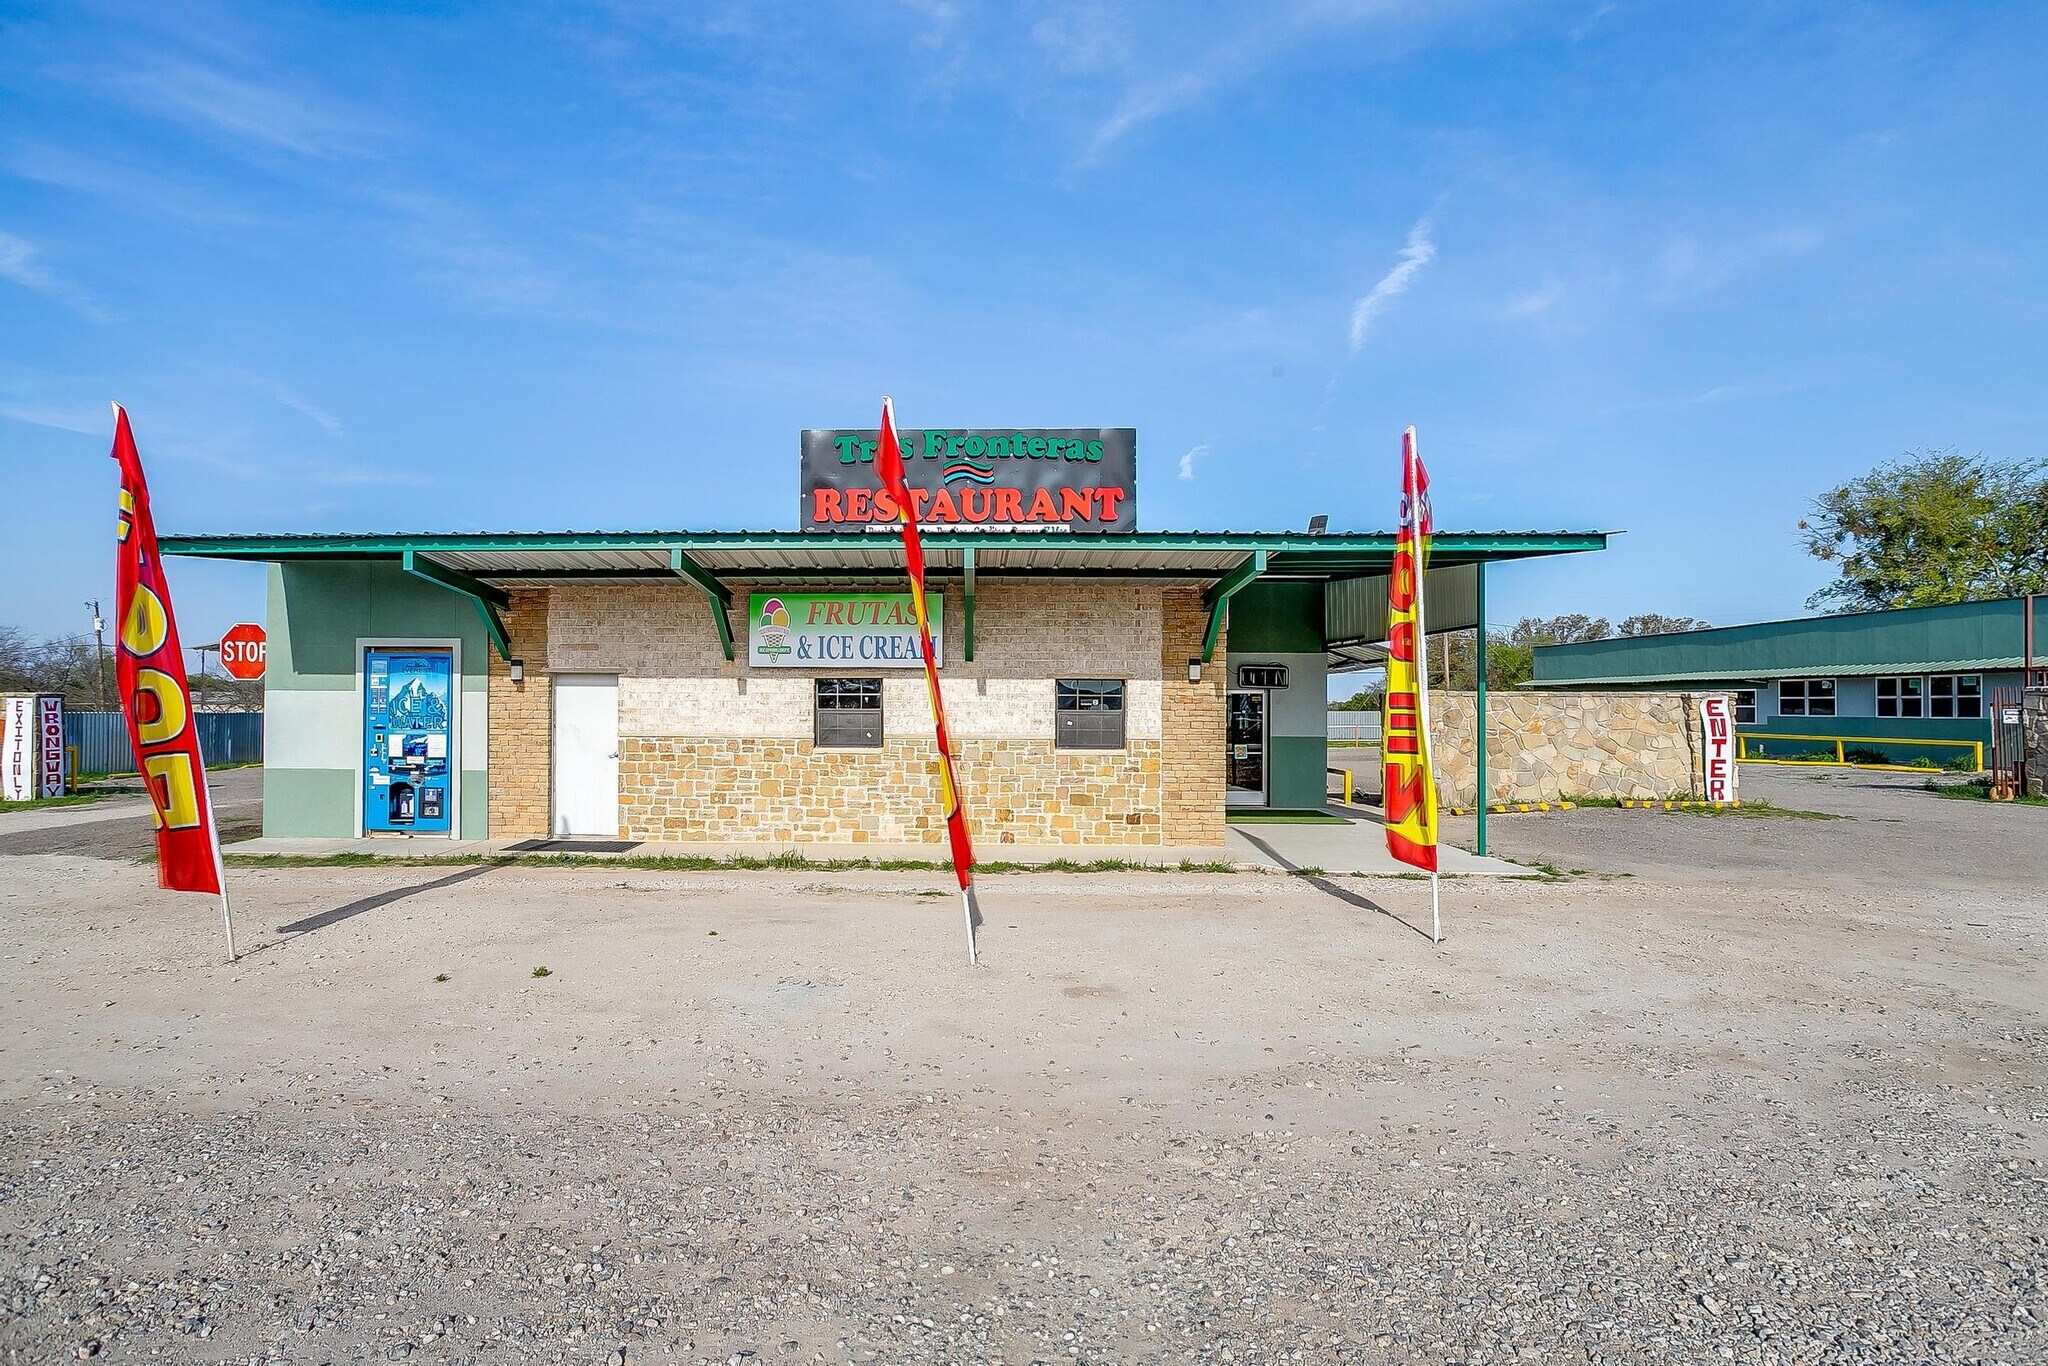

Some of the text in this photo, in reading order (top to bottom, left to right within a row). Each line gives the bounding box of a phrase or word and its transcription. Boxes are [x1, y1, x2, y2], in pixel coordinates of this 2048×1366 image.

[834, 429, 1105, 464] Trs Fronteras
[812, 487, 1125, 523] RESTAURANT
[805, 601, 918, 626] FRUTAS
[797, 635, 813, 660] &
[817, 635, 854, 660] ICE
[390, 716, 445, 729] WATER
[393, 697, 442, 716] ICE &
[13, 701, 23, 800] EXIT ONLY
[43, 700, 61, 797] WRONG WAY
[1706, 699, 1727, 801] ENTER
